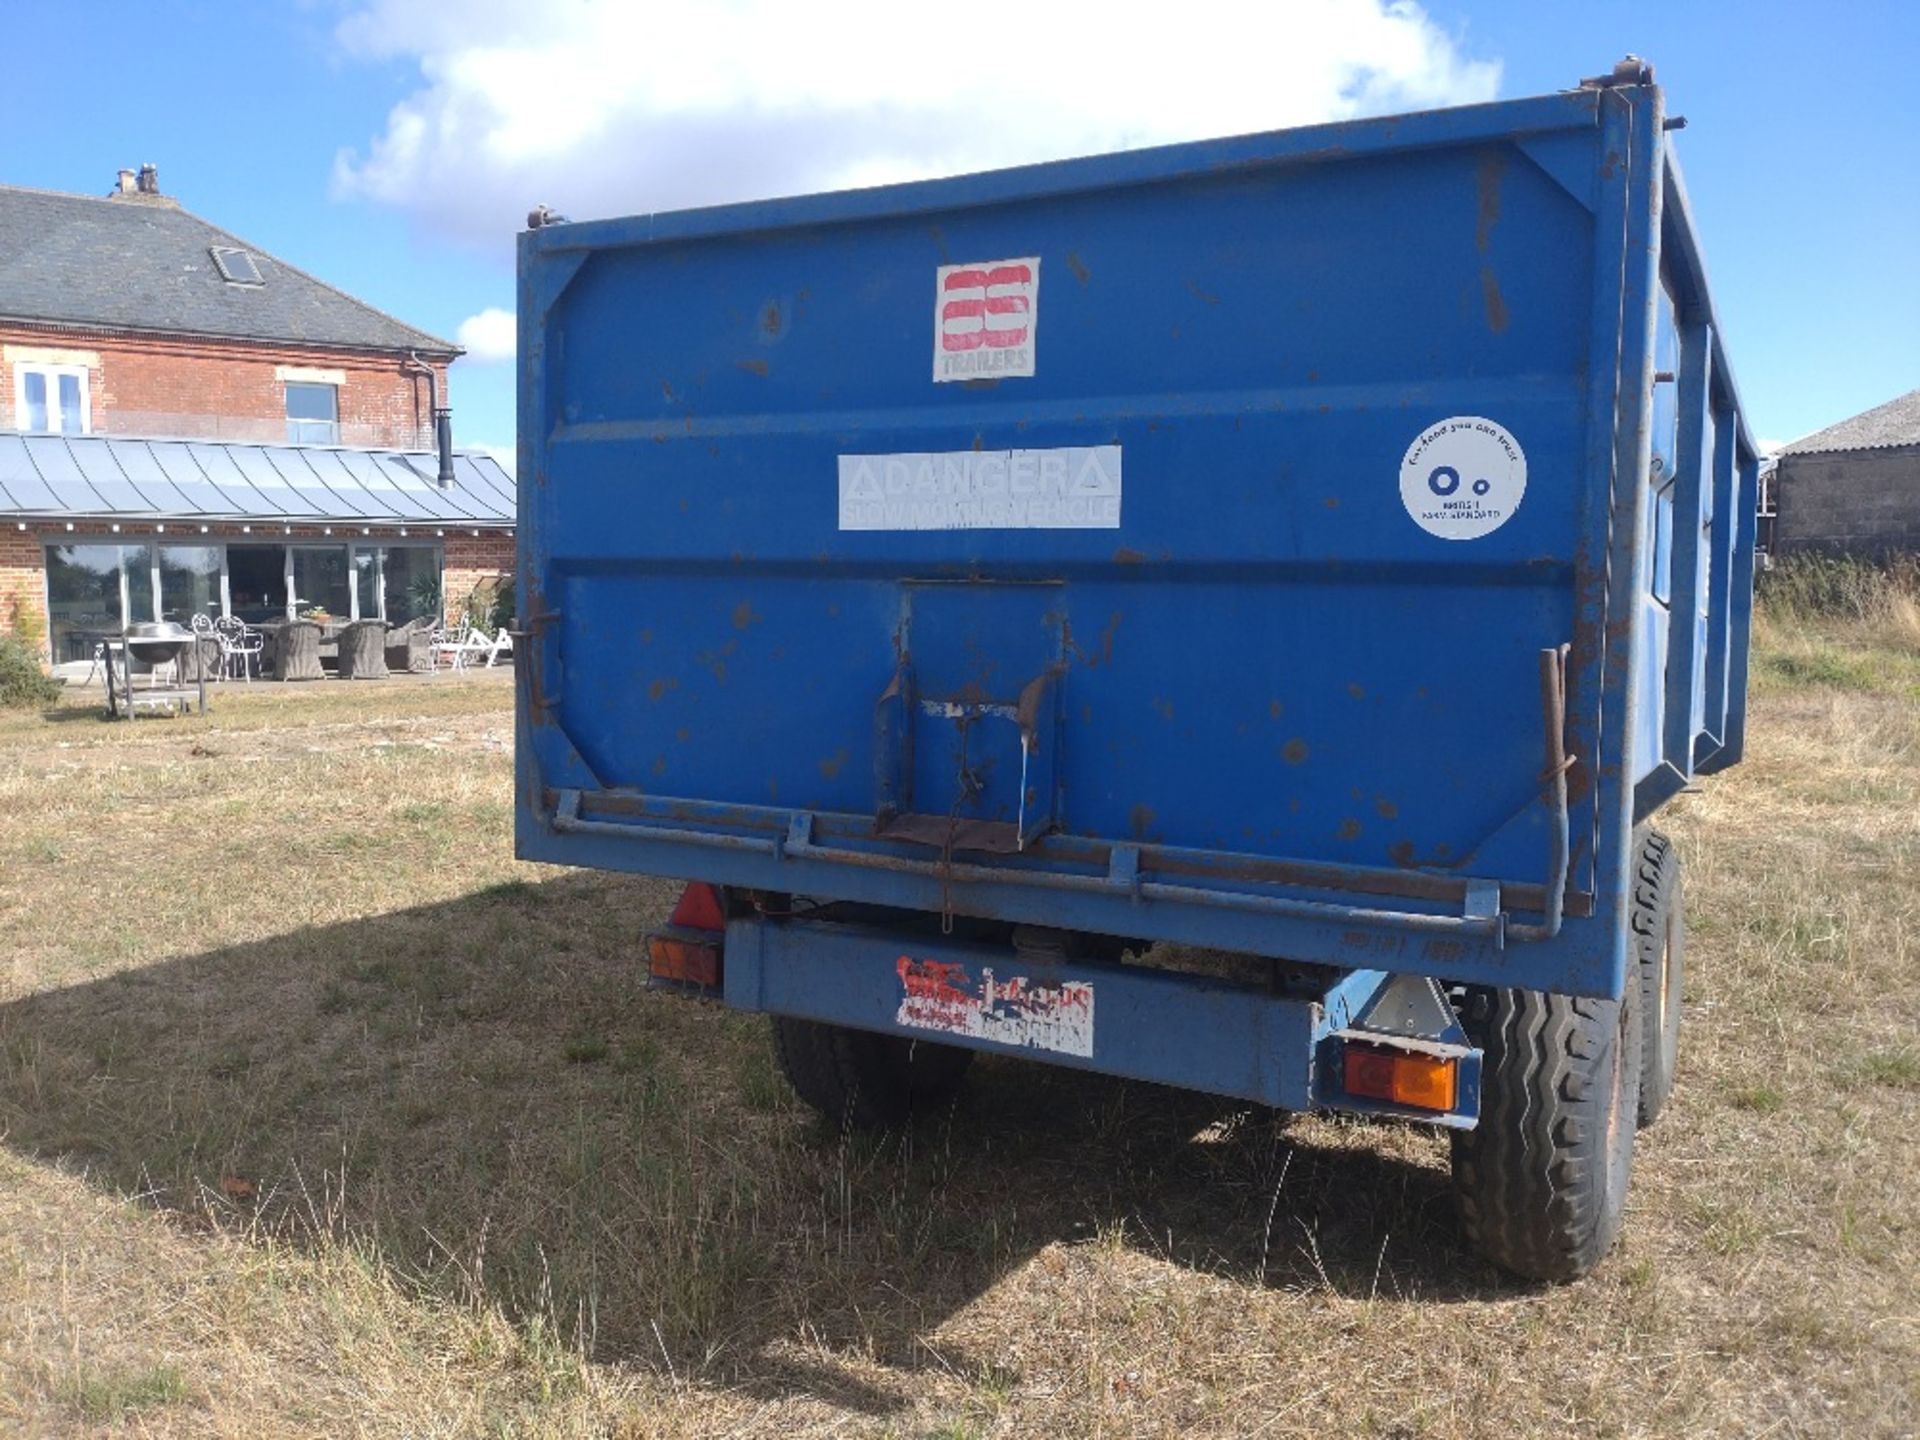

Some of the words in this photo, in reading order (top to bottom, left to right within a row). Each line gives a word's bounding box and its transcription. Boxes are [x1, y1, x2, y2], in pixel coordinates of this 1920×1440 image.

[940, 349, 1028, 374] TRAILERS
[886, 457, 1067, 494] DANGER
[844, 504, 903, 524] SLOW
[913, 503, 1005, 524] MOVING
[1014, 500, 1117, 523] VEHICLE
